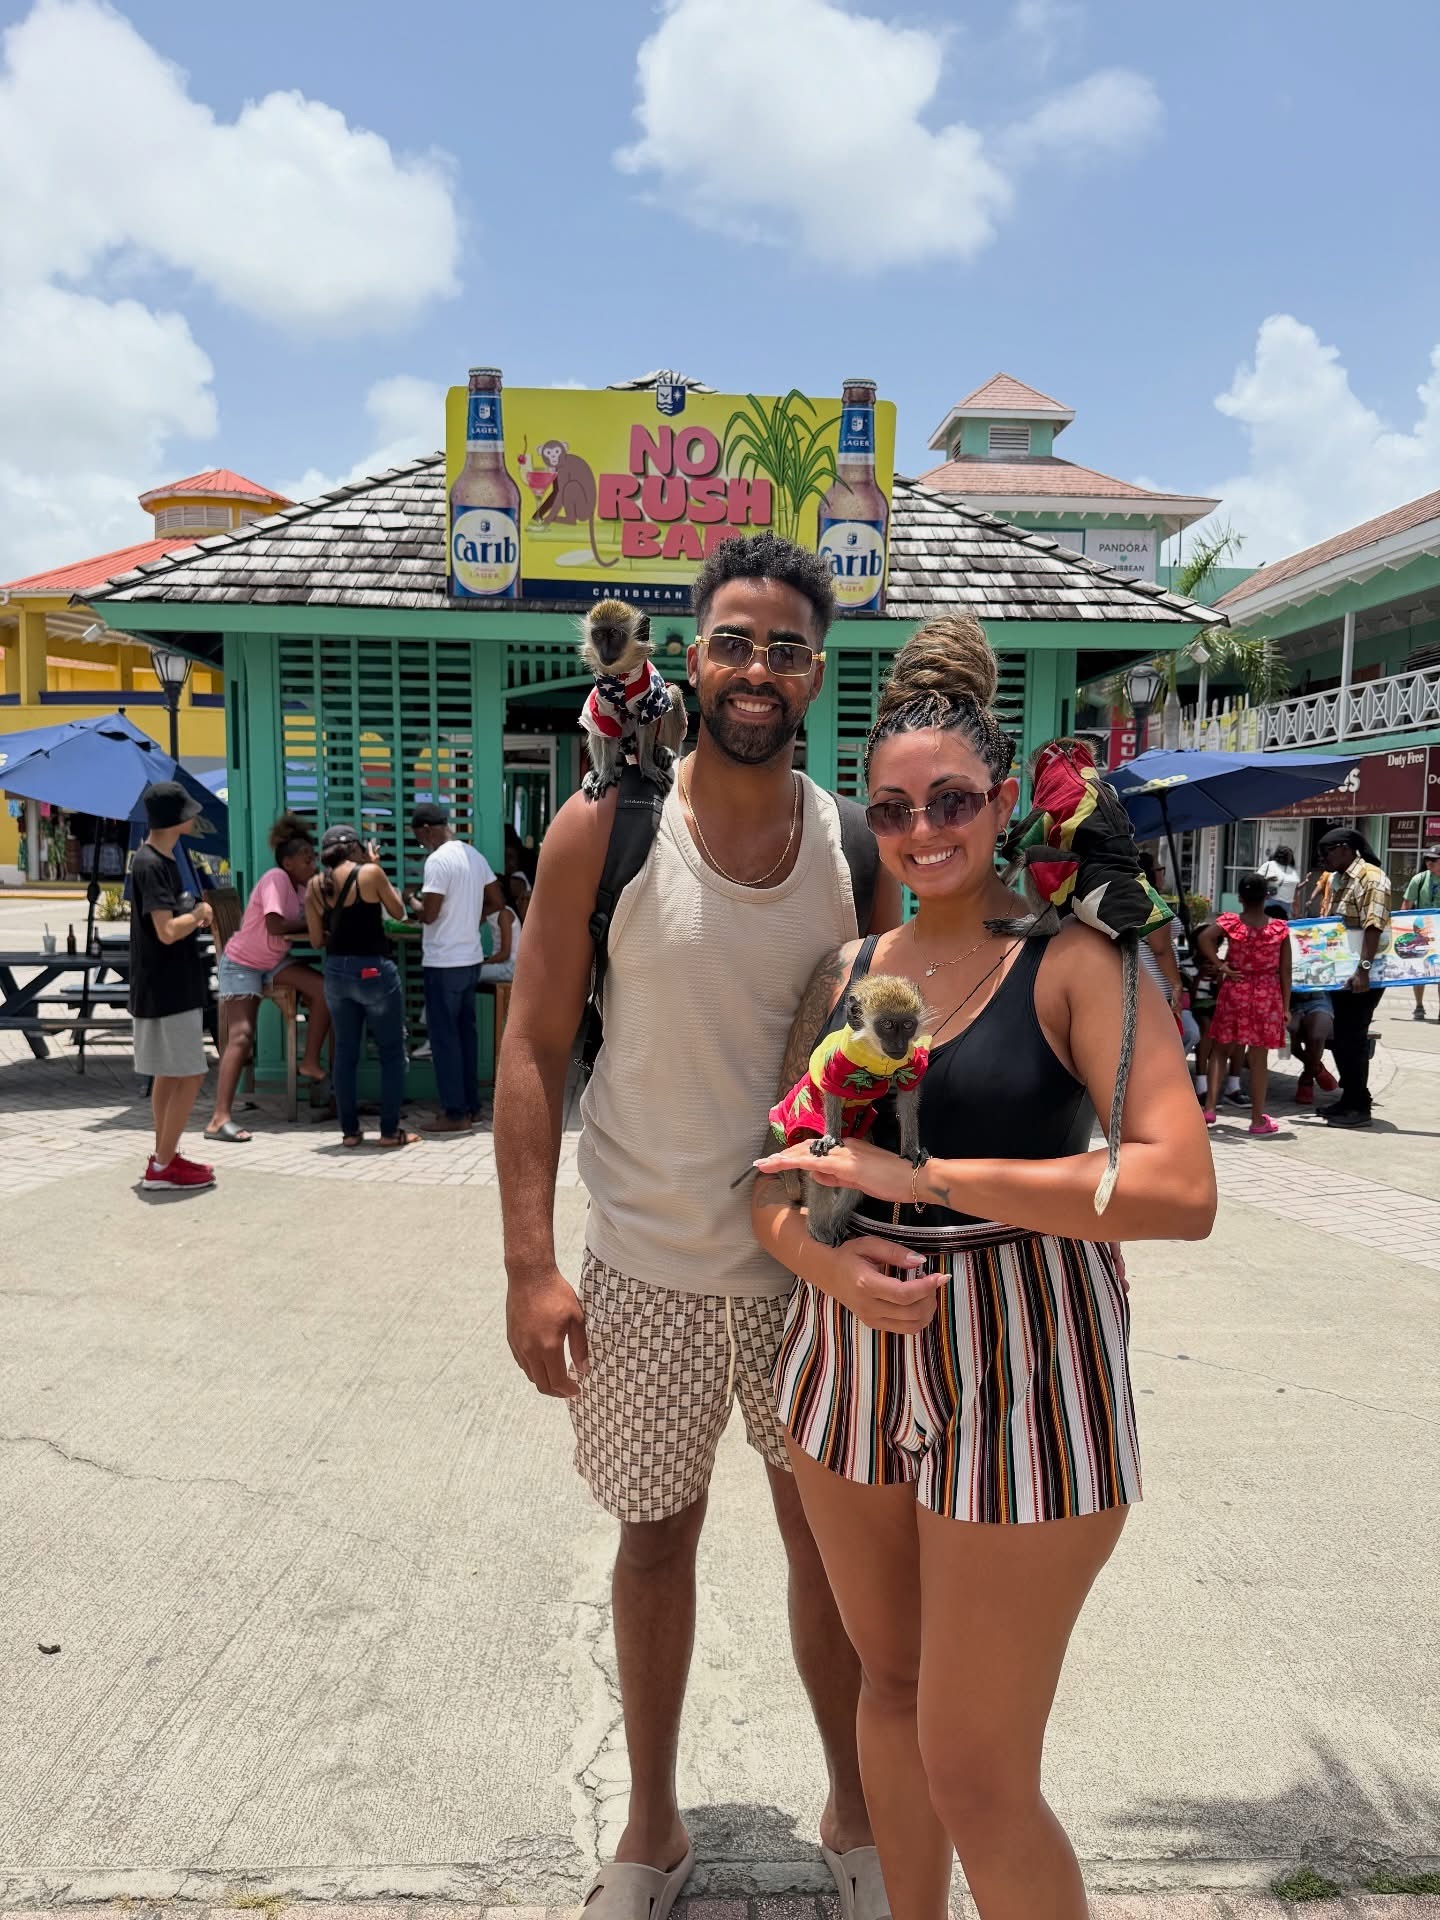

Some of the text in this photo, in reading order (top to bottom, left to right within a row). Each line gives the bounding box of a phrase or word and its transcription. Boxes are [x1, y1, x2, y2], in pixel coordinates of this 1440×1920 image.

[629, 424, 720, 476] NO
[598, 474, 772, 525] RUSH
[454, 533, 517, 564] Carib
[1098, 543, 1148, 553] PANDORA
[592, 587, 683, 599] CARIBBEAN
[836, 585, 865, 593] AGER
[1387, 751, 1425, 769] Duty Free
